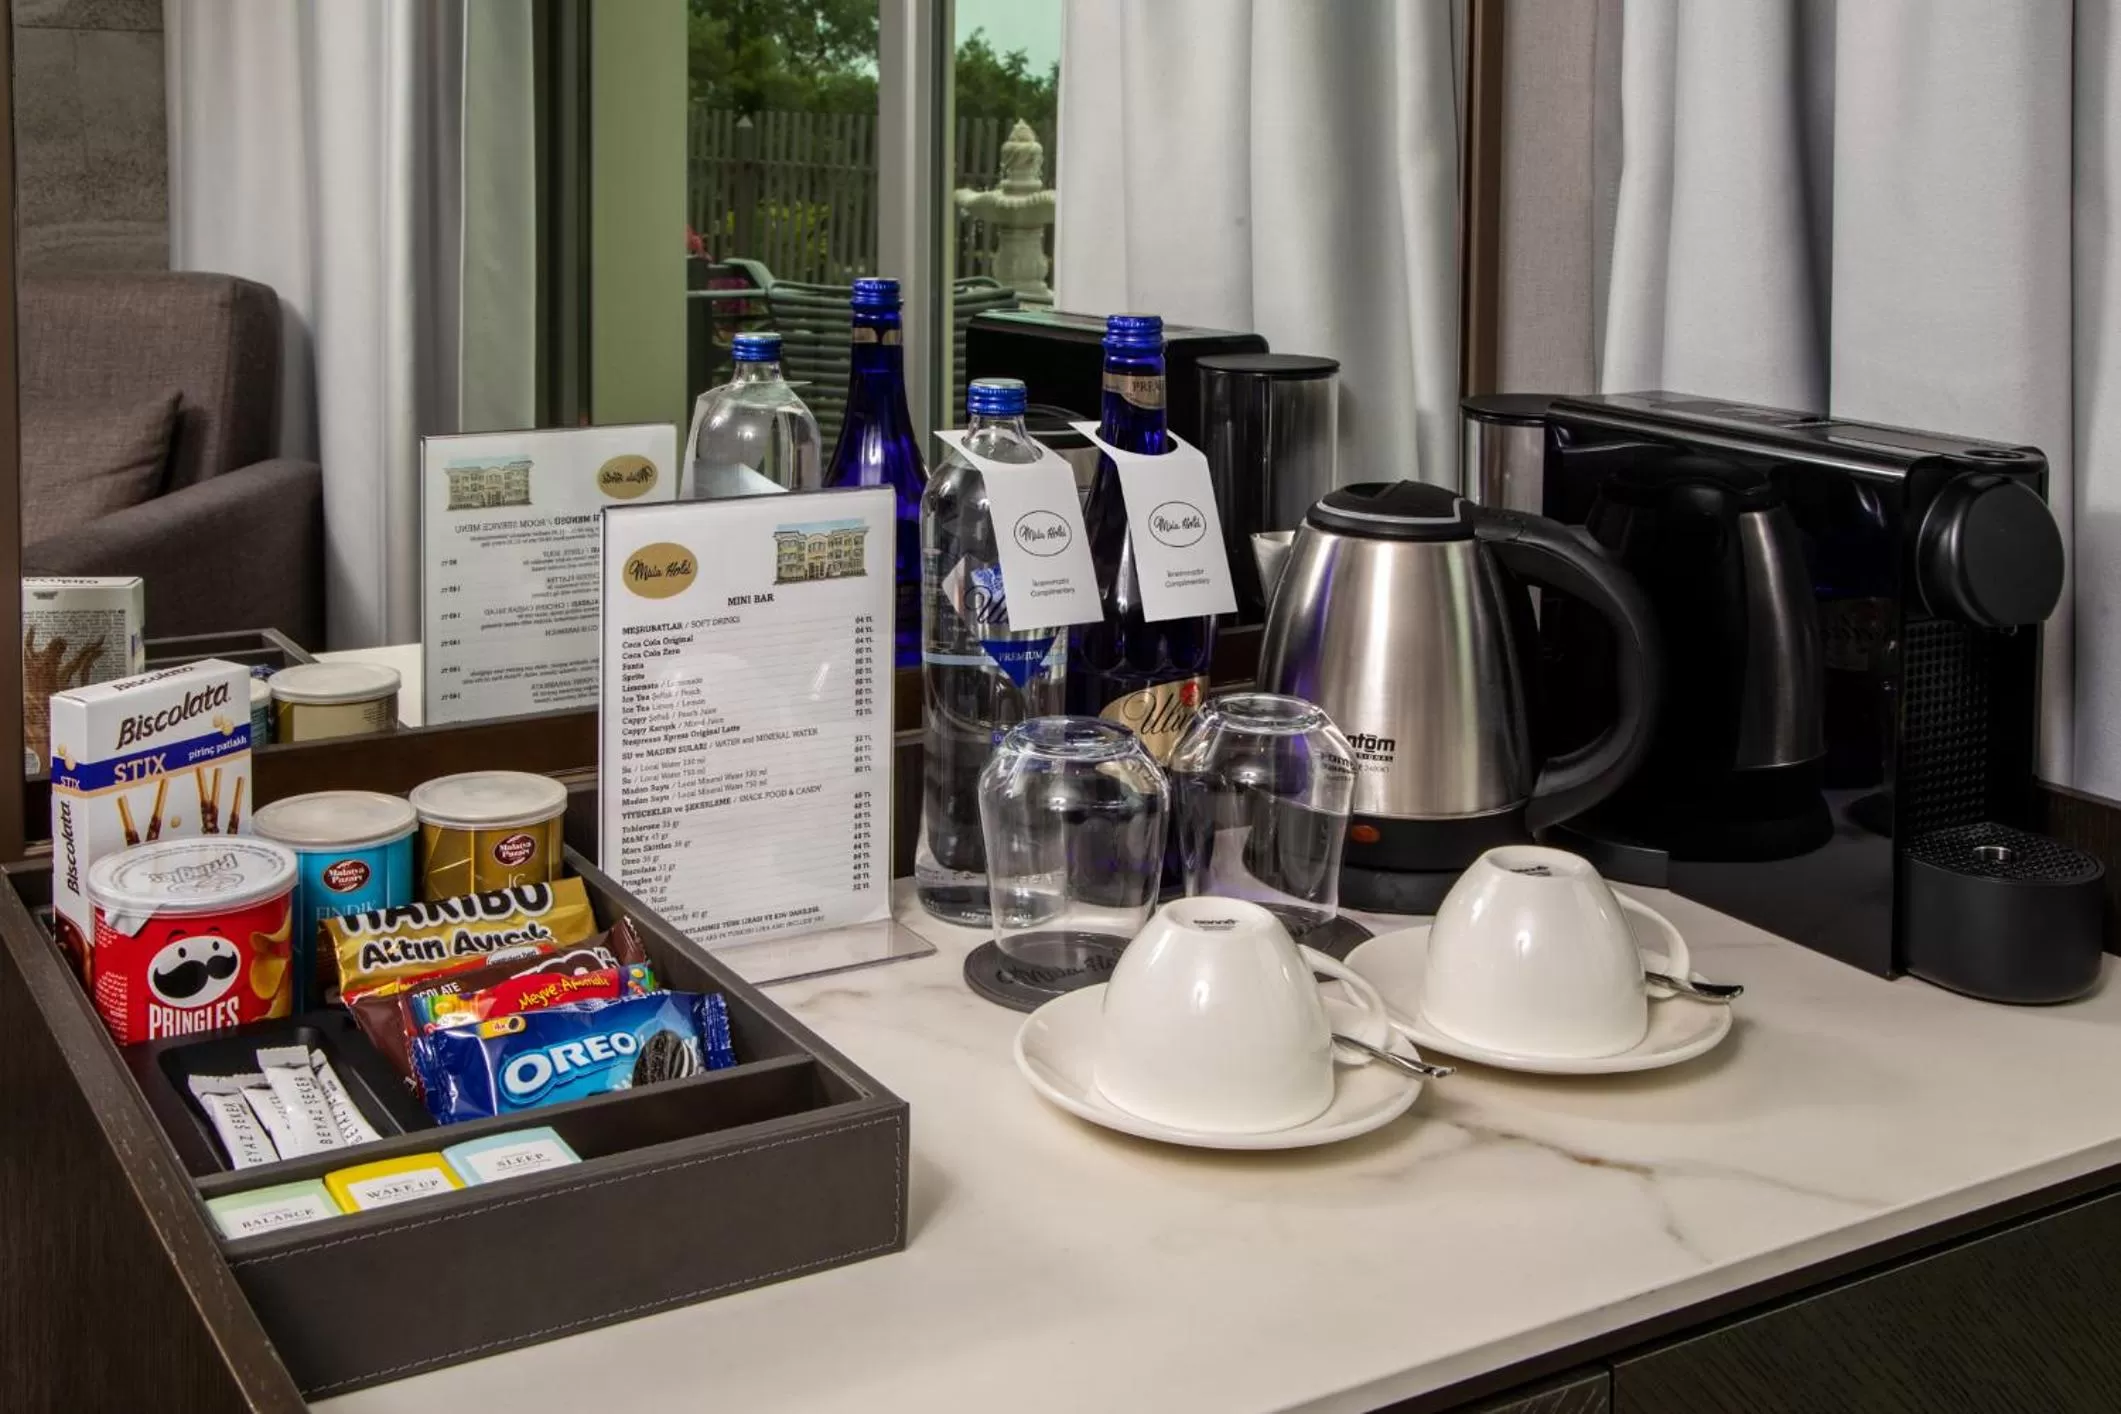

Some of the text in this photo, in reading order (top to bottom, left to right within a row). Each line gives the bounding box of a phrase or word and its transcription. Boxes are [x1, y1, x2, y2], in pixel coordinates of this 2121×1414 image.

[727, 593, 775, 606] MINI BAR
[621, 641, 641, 649] Coca
[662, 635, 694, 646] Original
[621, 652, 641, 660] Coca
[662, 647, 681, 656] Zero
[1000, 650, 1044, 662] PREMIUM
[621, 662, 645, 671] Fanta
[112, 666, 195, 692] Biscolata
[621, 673, 646, 682] Sprite
[115, 681, 230, 750] Biscolata
[621, 716, 647, 726] Cappy
[621, 727, 647, 736] Cappy
[690, 727, 721, 738] Original
[113, 735, 247, 784] STIX pirinç patlaklı
[59, 775, 81, 790] STIX
[795, 784, 823, 796] CANDY
[60, 801, 81, 896] Biscolata
[500, 841, 532, 852] Malatya
[328, 866, 365, 877] Malatya
[360, 937, 448, 973] Altın
[518, 983, 559, 1010] Meyve
[148, 996, 241, 1041] PRINGLES
[502, 1031, 639, 1096] OREO
[238, 1134, 263, 1163] EYAZ
[496, 1152, 544, 1167] SLEEP
[365, 1184, 413, 1199] WAKE
[419, 1178, 440, 1191] UP
[242, 1207, 316, 1231] BALANCE
